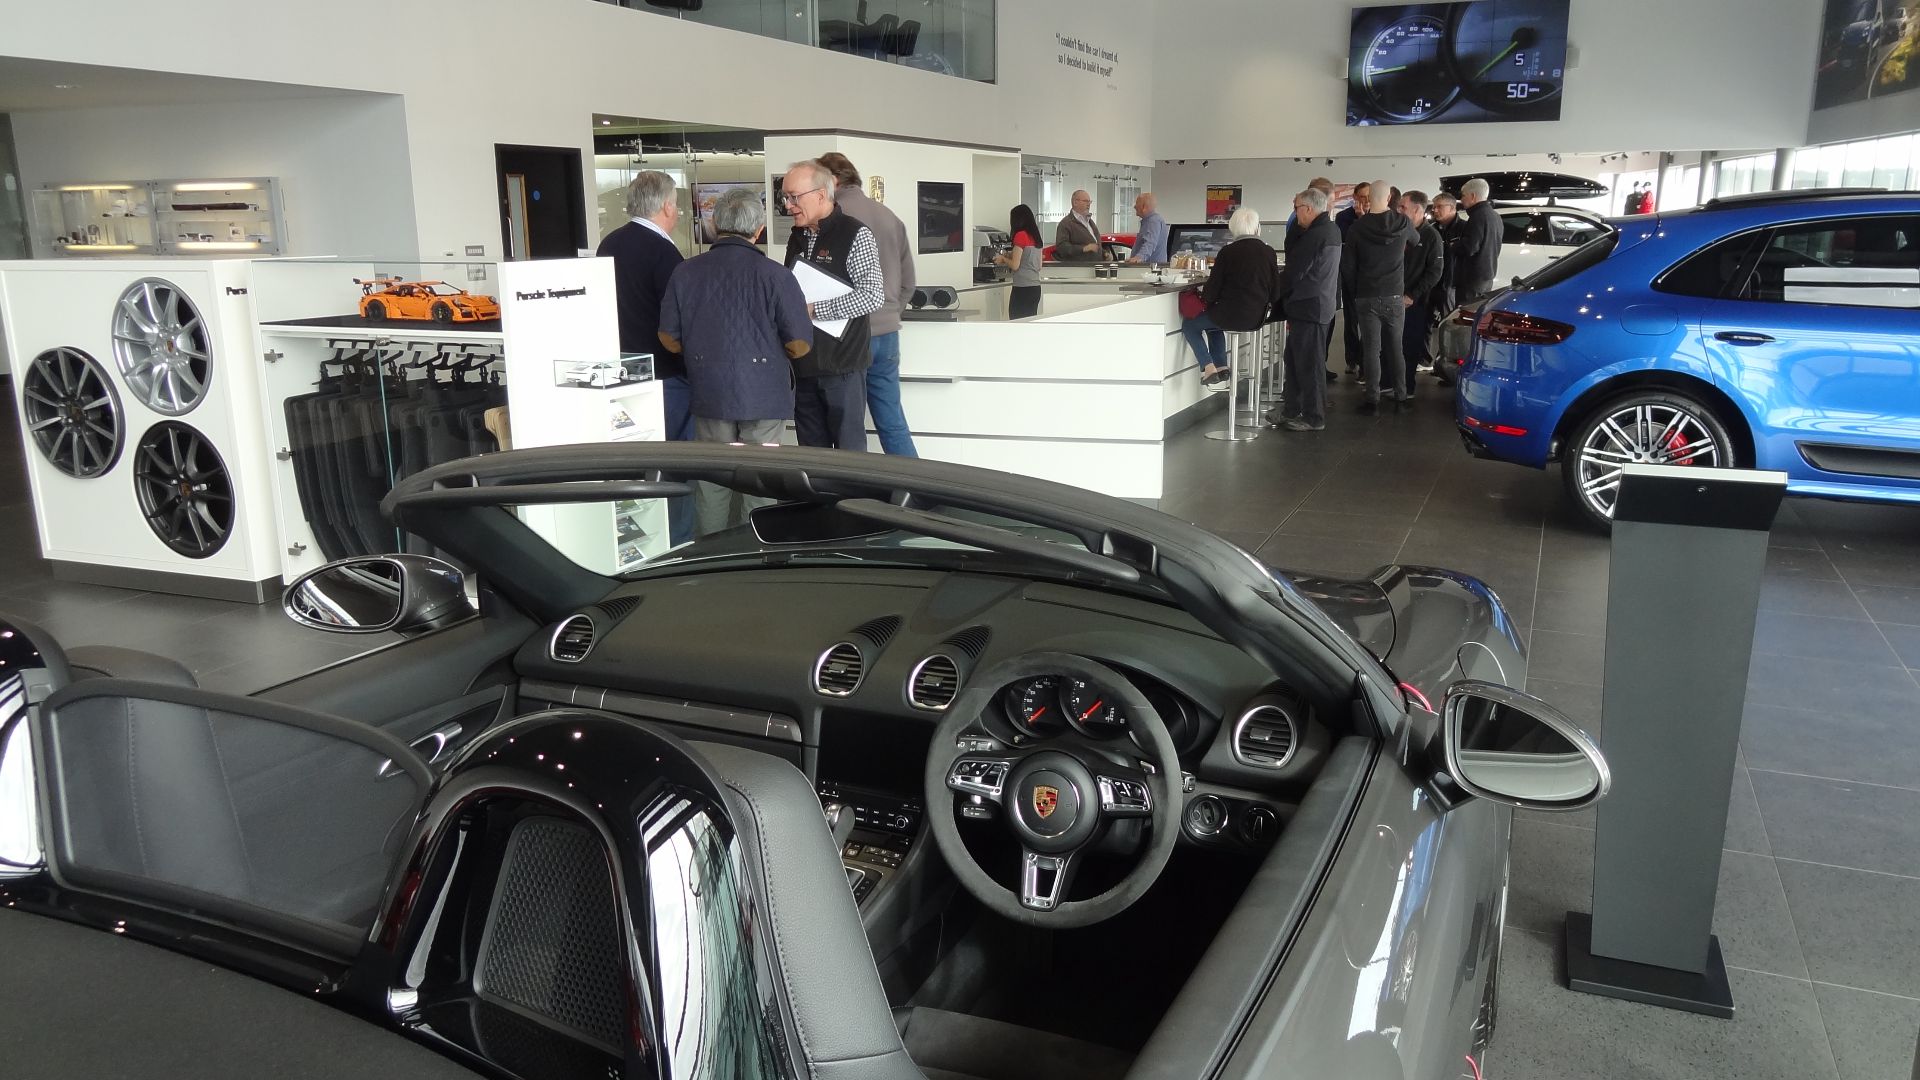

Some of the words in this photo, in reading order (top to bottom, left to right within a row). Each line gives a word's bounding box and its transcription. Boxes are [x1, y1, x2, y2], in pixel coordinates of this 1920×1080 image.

[1077, 40, 1085, 52] find
[1058, 54, 1063, 63] so
[1066, 54, 1081, 69] decided
[1082, 59, 1086, 70] to
[1515, 53, 1524, 66] 5
[1507, 83, 1528, 98] 50
[1415, 99, 1423, 107] 17
[516, 289, 546, 301] Porsche
[546, 286, 587, 299] Tequipment
